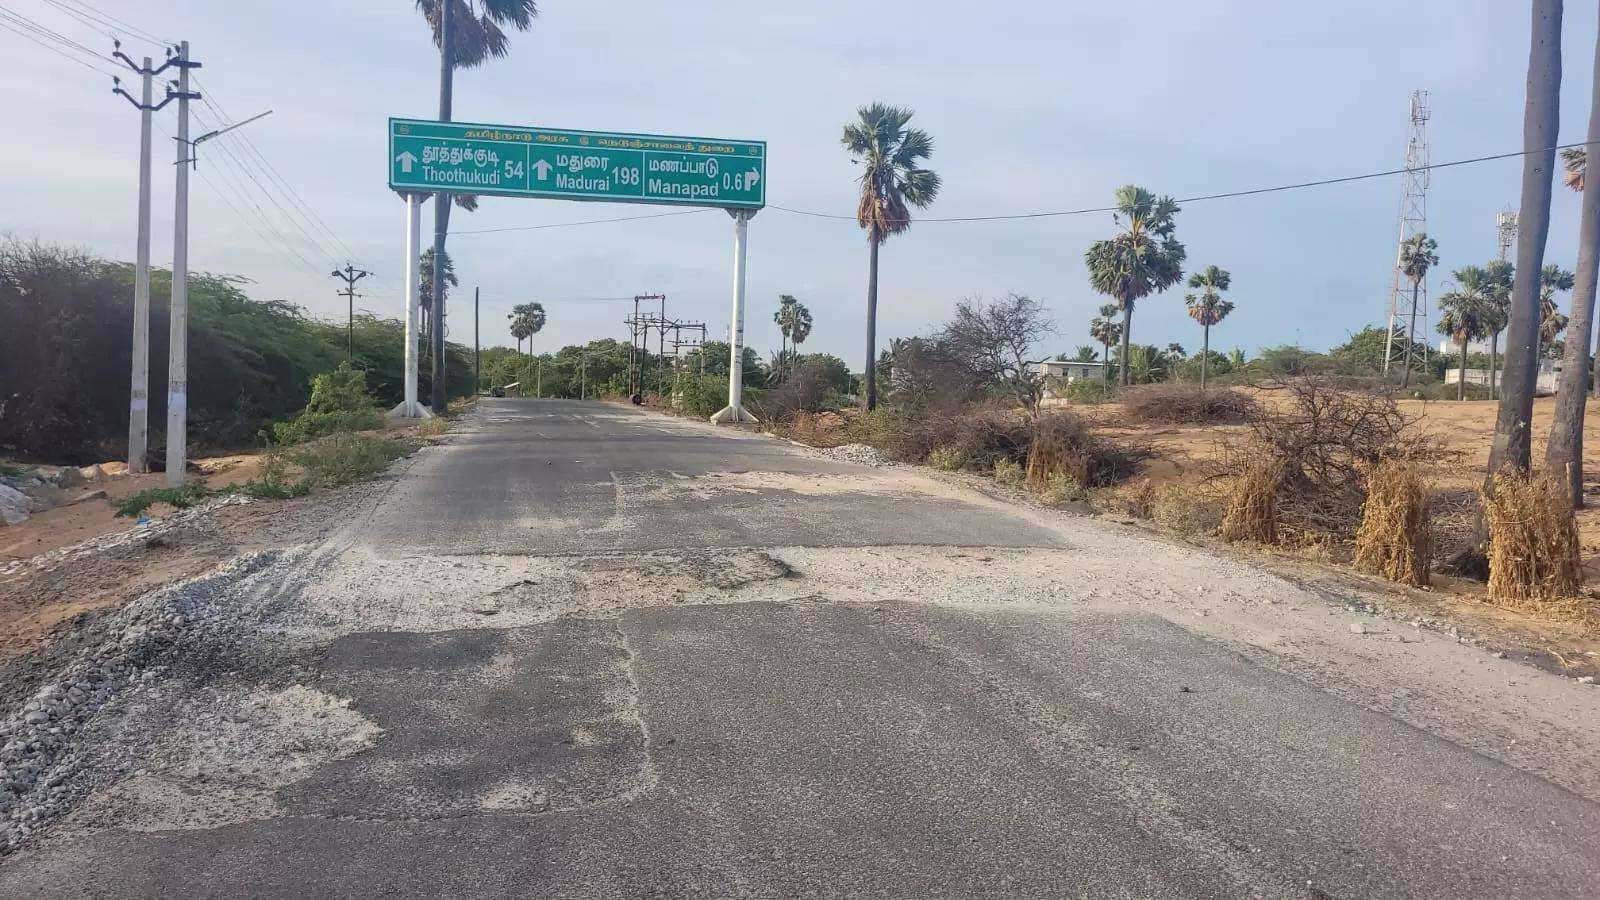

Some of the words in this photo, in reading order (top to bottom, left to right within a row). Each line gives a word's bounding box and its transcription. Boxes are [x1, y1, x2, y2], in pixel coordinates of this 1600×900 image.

[422, 141, 500, 167] தூத்துக்குடி
[556, 153, 609, 172] மதுரை
[422, 165, 500, 185] Thoothukudi
[504, 160, 524, 180] 54
[612, 166, 640, 186] 198
[648, 155, 720, 179] மணப்பாடு
[556, 173, 609, 191] Madurai
[648, 178, 719, 199] Manapad
[722, 172, 743, 191] 0.6
